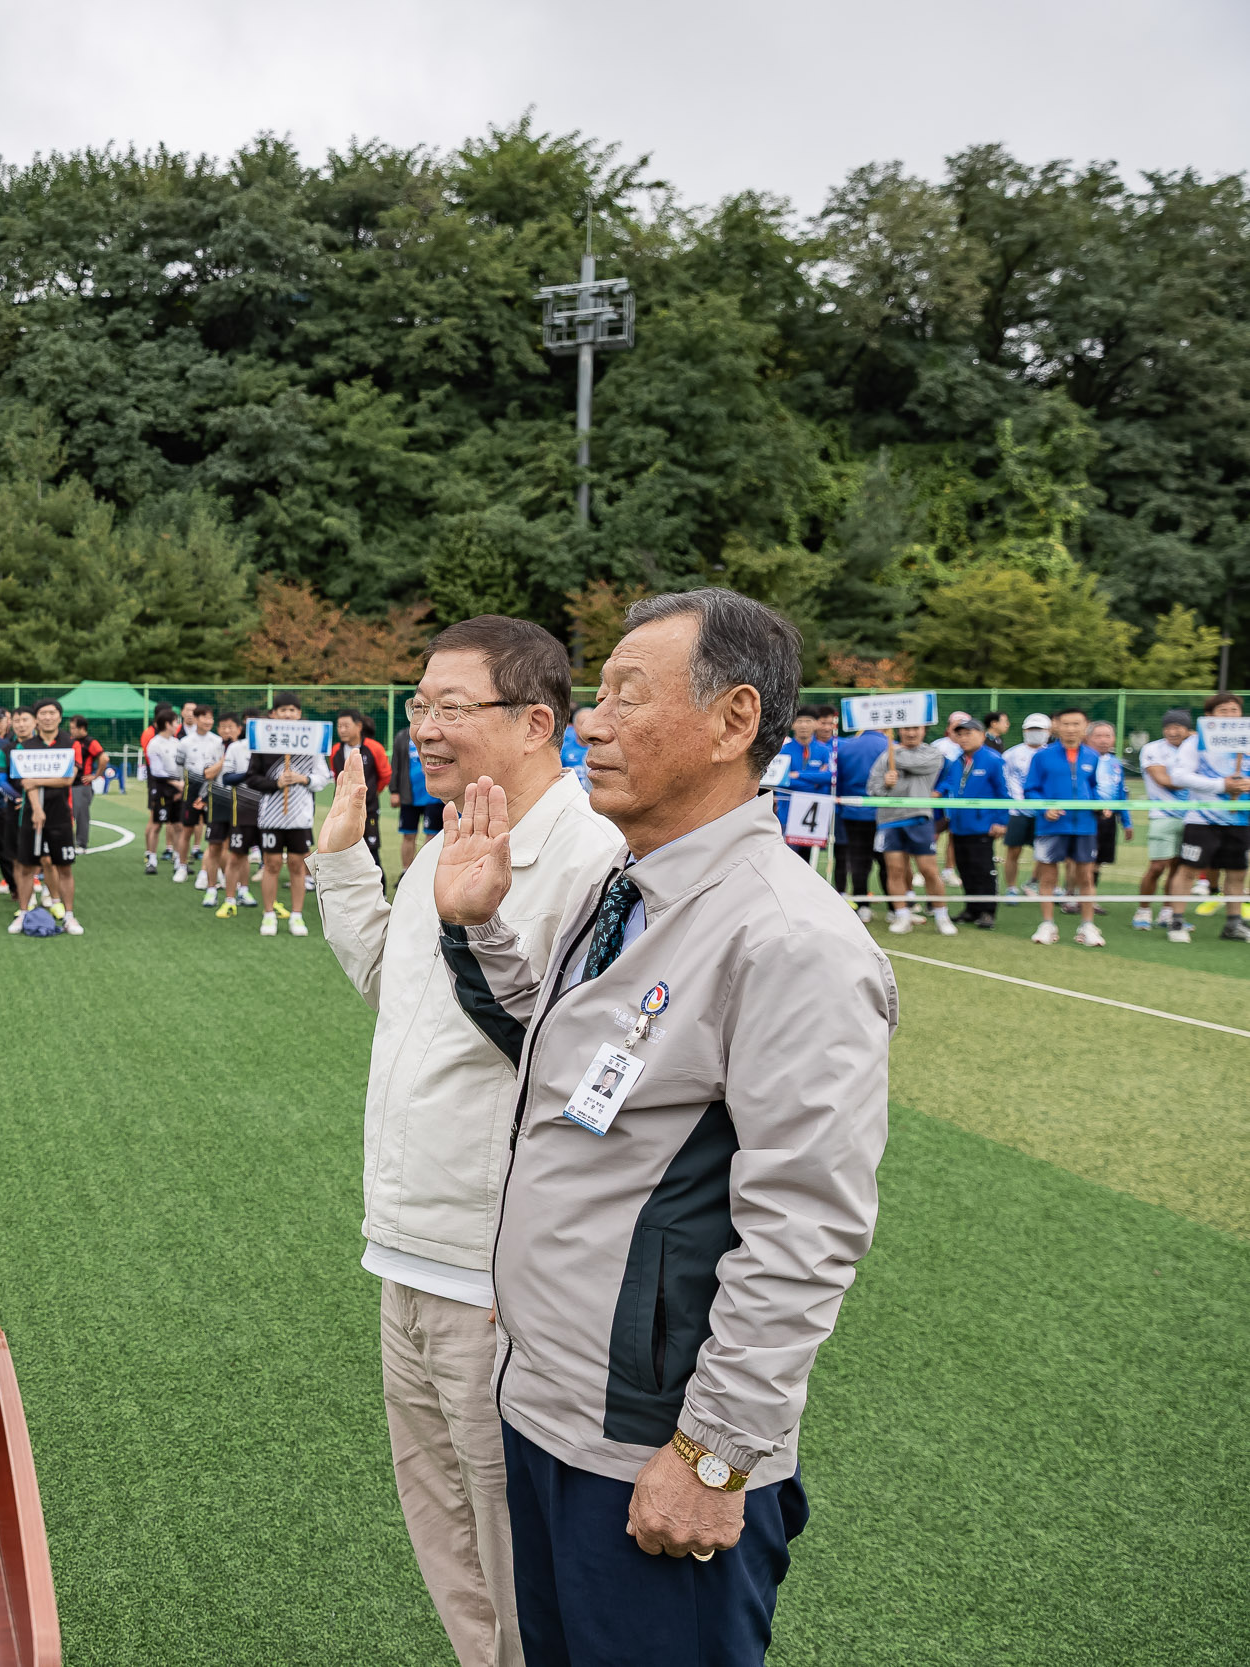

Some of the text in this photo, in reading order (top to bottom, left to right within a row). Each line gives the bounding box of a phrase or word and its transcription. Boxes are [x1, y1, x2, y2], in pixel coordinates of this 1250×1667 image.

[871, 708, 906, 725] 무궁화
[269, 733, 309, 748] 중곡JC
[802, 801, 819, 833] 4
[261, 833, 277, 848] 10
[61, 846, 75, 860] 13
